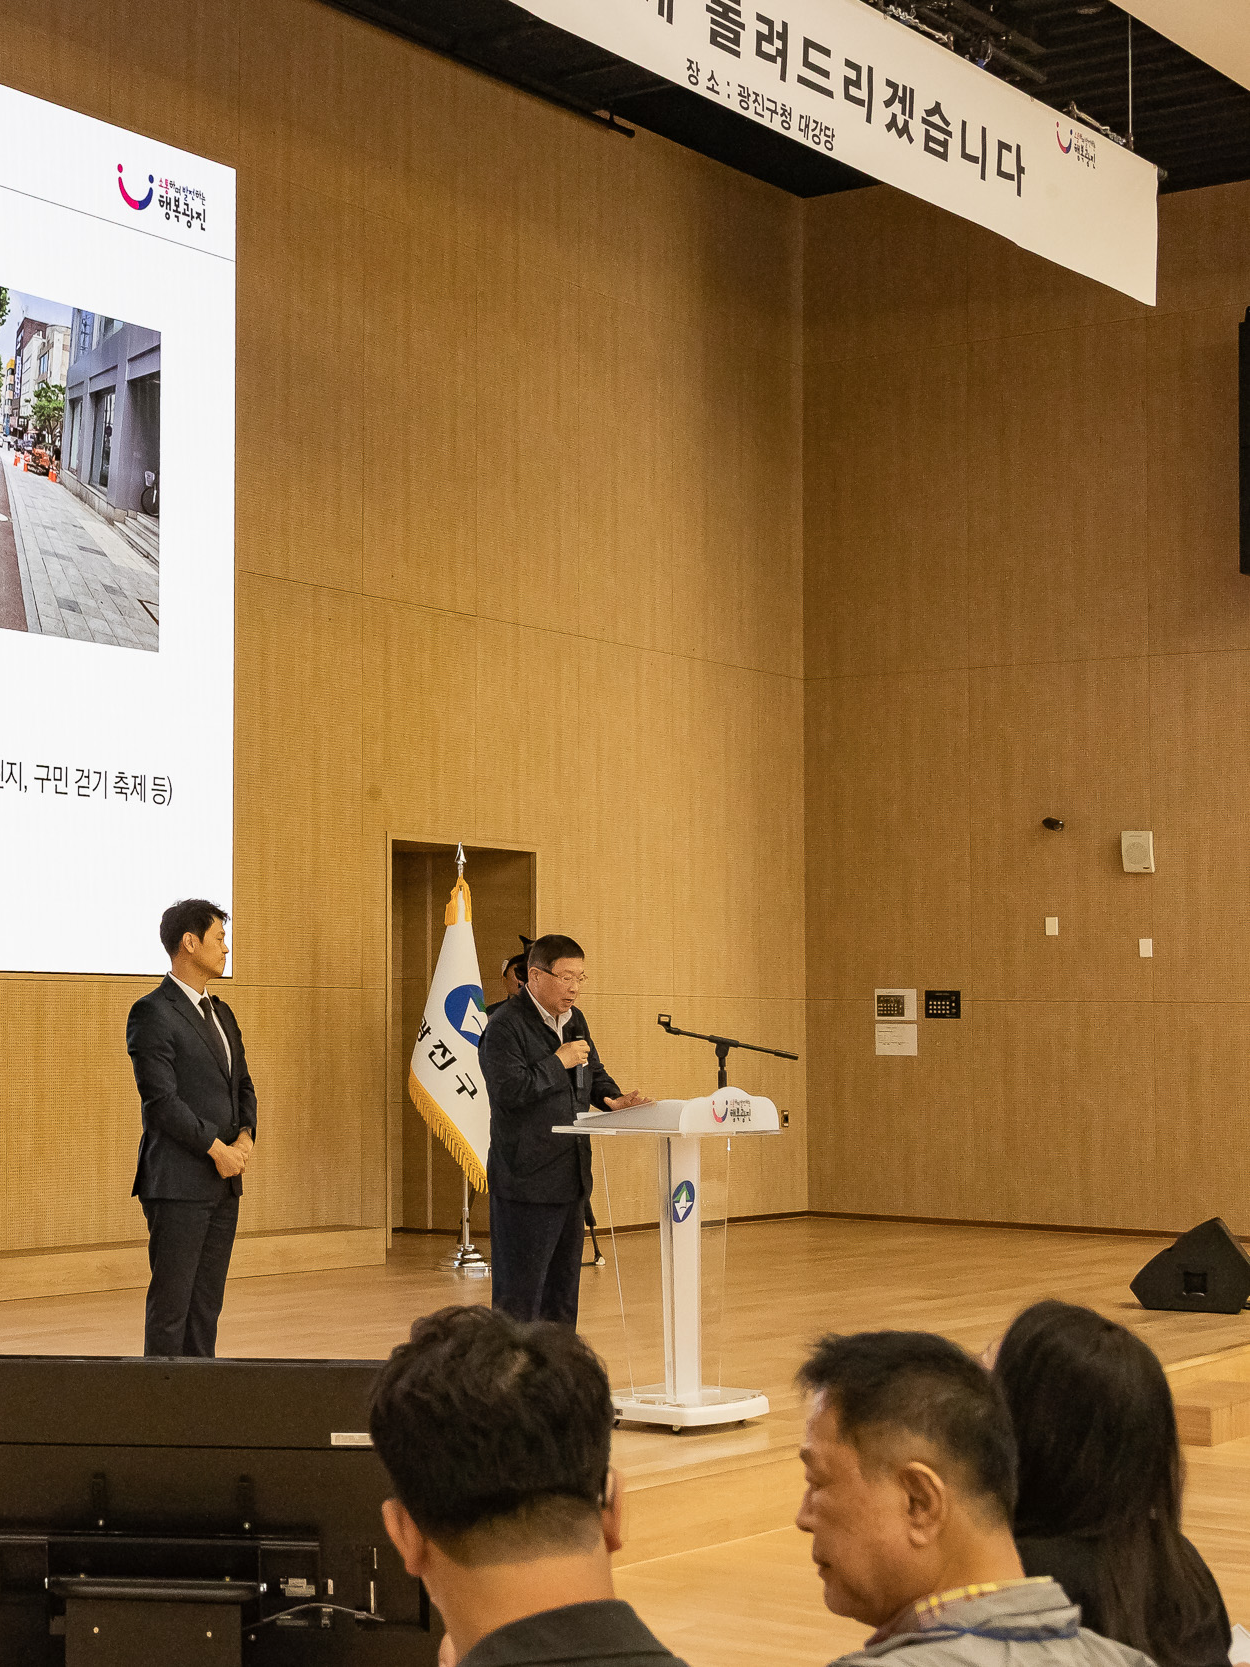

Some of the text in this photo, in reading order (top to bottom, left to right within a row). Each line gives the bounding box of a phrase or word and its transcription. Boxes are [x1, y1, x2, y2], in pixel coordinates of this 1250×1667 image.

[705, 0, 1026, 197] 돌려드리겠습니다
[737, 83, 793, 131] 광진구청
[798, 113, 836, 151] 대강당
[158, 194, 206, 231] 행복광진
[34, 765, 68, 795] 구민
[75, 769, 107, 799] 걷기
[113, 772, 145, 802] 축제
[151, 776, 172, 806] 등)
